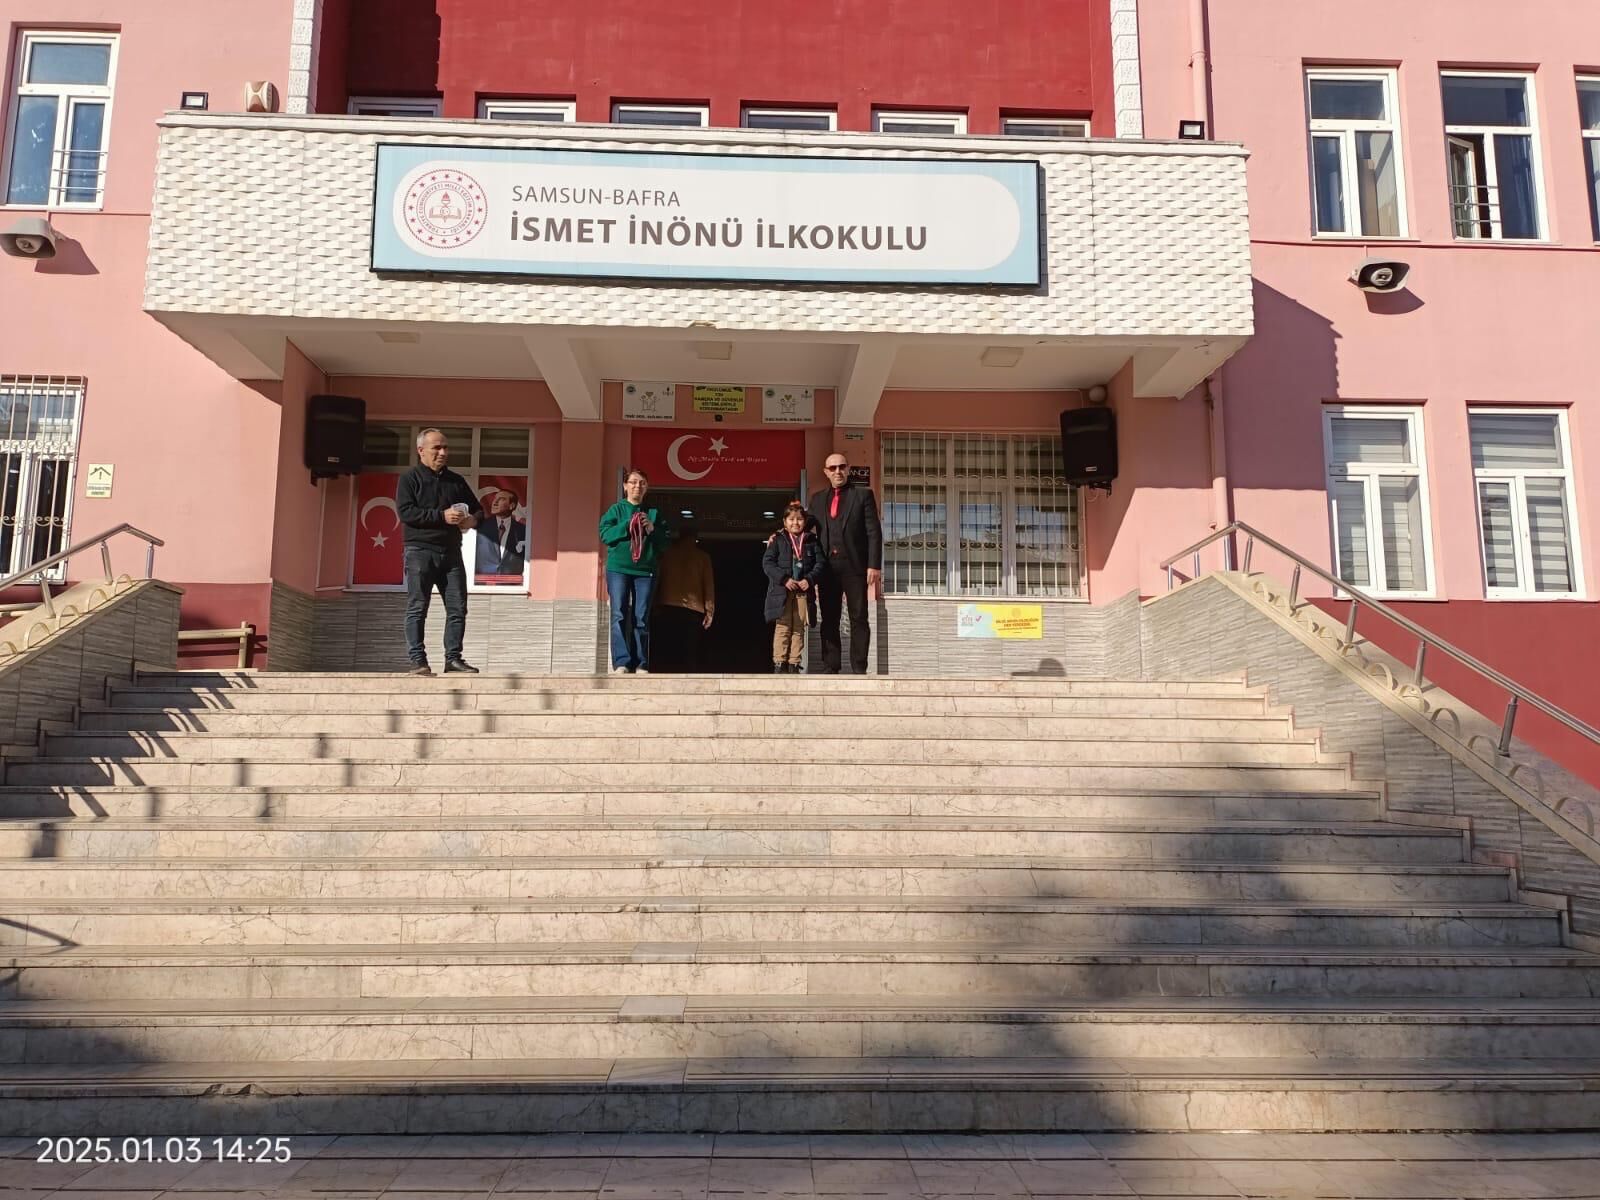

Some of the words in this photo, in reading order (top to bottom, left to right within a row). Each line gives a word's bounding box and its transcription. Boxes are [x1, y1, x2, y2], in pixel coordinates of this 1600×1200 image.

[512, 185, 681, 207] SAMSUN-BAFRA
[510, 210, 617, 244] İSMET
[629, 214, 743, 248] İNÖNÜ
[756, 217, 927, 250] İLKOKULU
